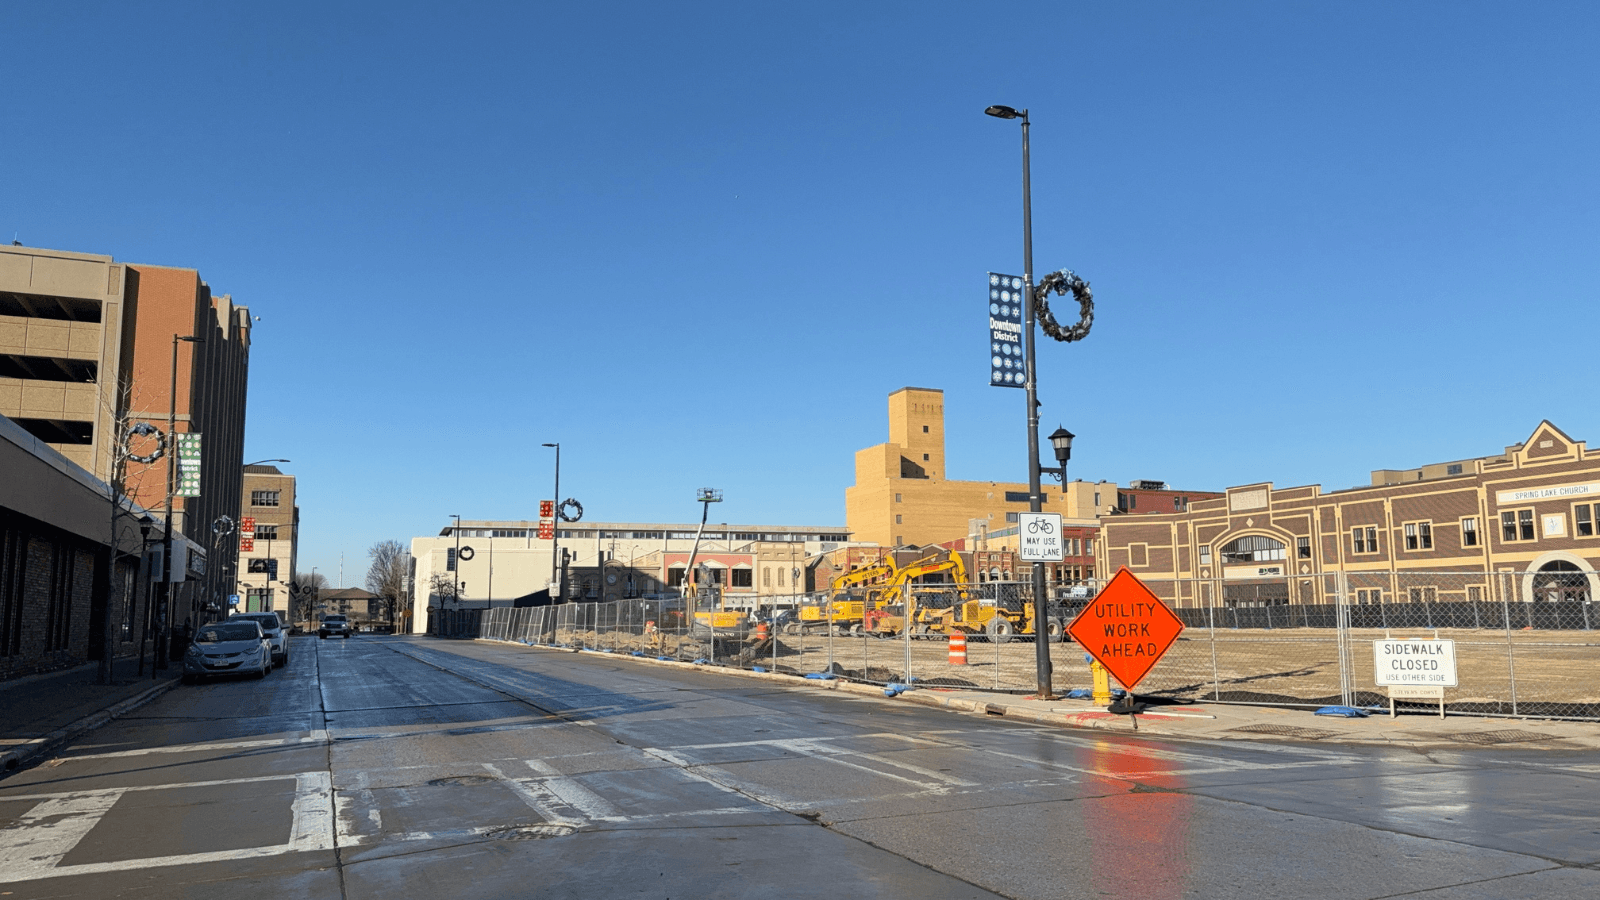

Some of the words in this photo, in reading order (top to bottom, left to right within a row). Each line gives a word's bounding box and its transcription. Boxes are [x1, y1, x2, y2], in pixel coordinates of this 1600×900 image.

[990, 317, 1022, 333] Downtown
[994, 331, 1018, 342] District
[1515, 491, 1539, 499] SPRING
[1541, 489, 1558, 497] LAKE
[1560, 486, 1589, 495] CHURCH
[1026, 537, 1040, 545] MAY
[1043, 537, 1056, 545] USE
[1023, 547, 1040, 556] FULL
[1043, 548, 1060, 556] LANE
[1095, 603, 1156, 618] UTILITY
[1104, 623, 1150, 637] WORK
[1101, 643, 1157, 657] AHEAD
[1384, 644, 1443, 655] SIDEWALK
[1391, 659, 1438, 670] CLOSED
[1386, 673, 1400, 681] USE
[1428, 674, 1446, 682] SIDE
